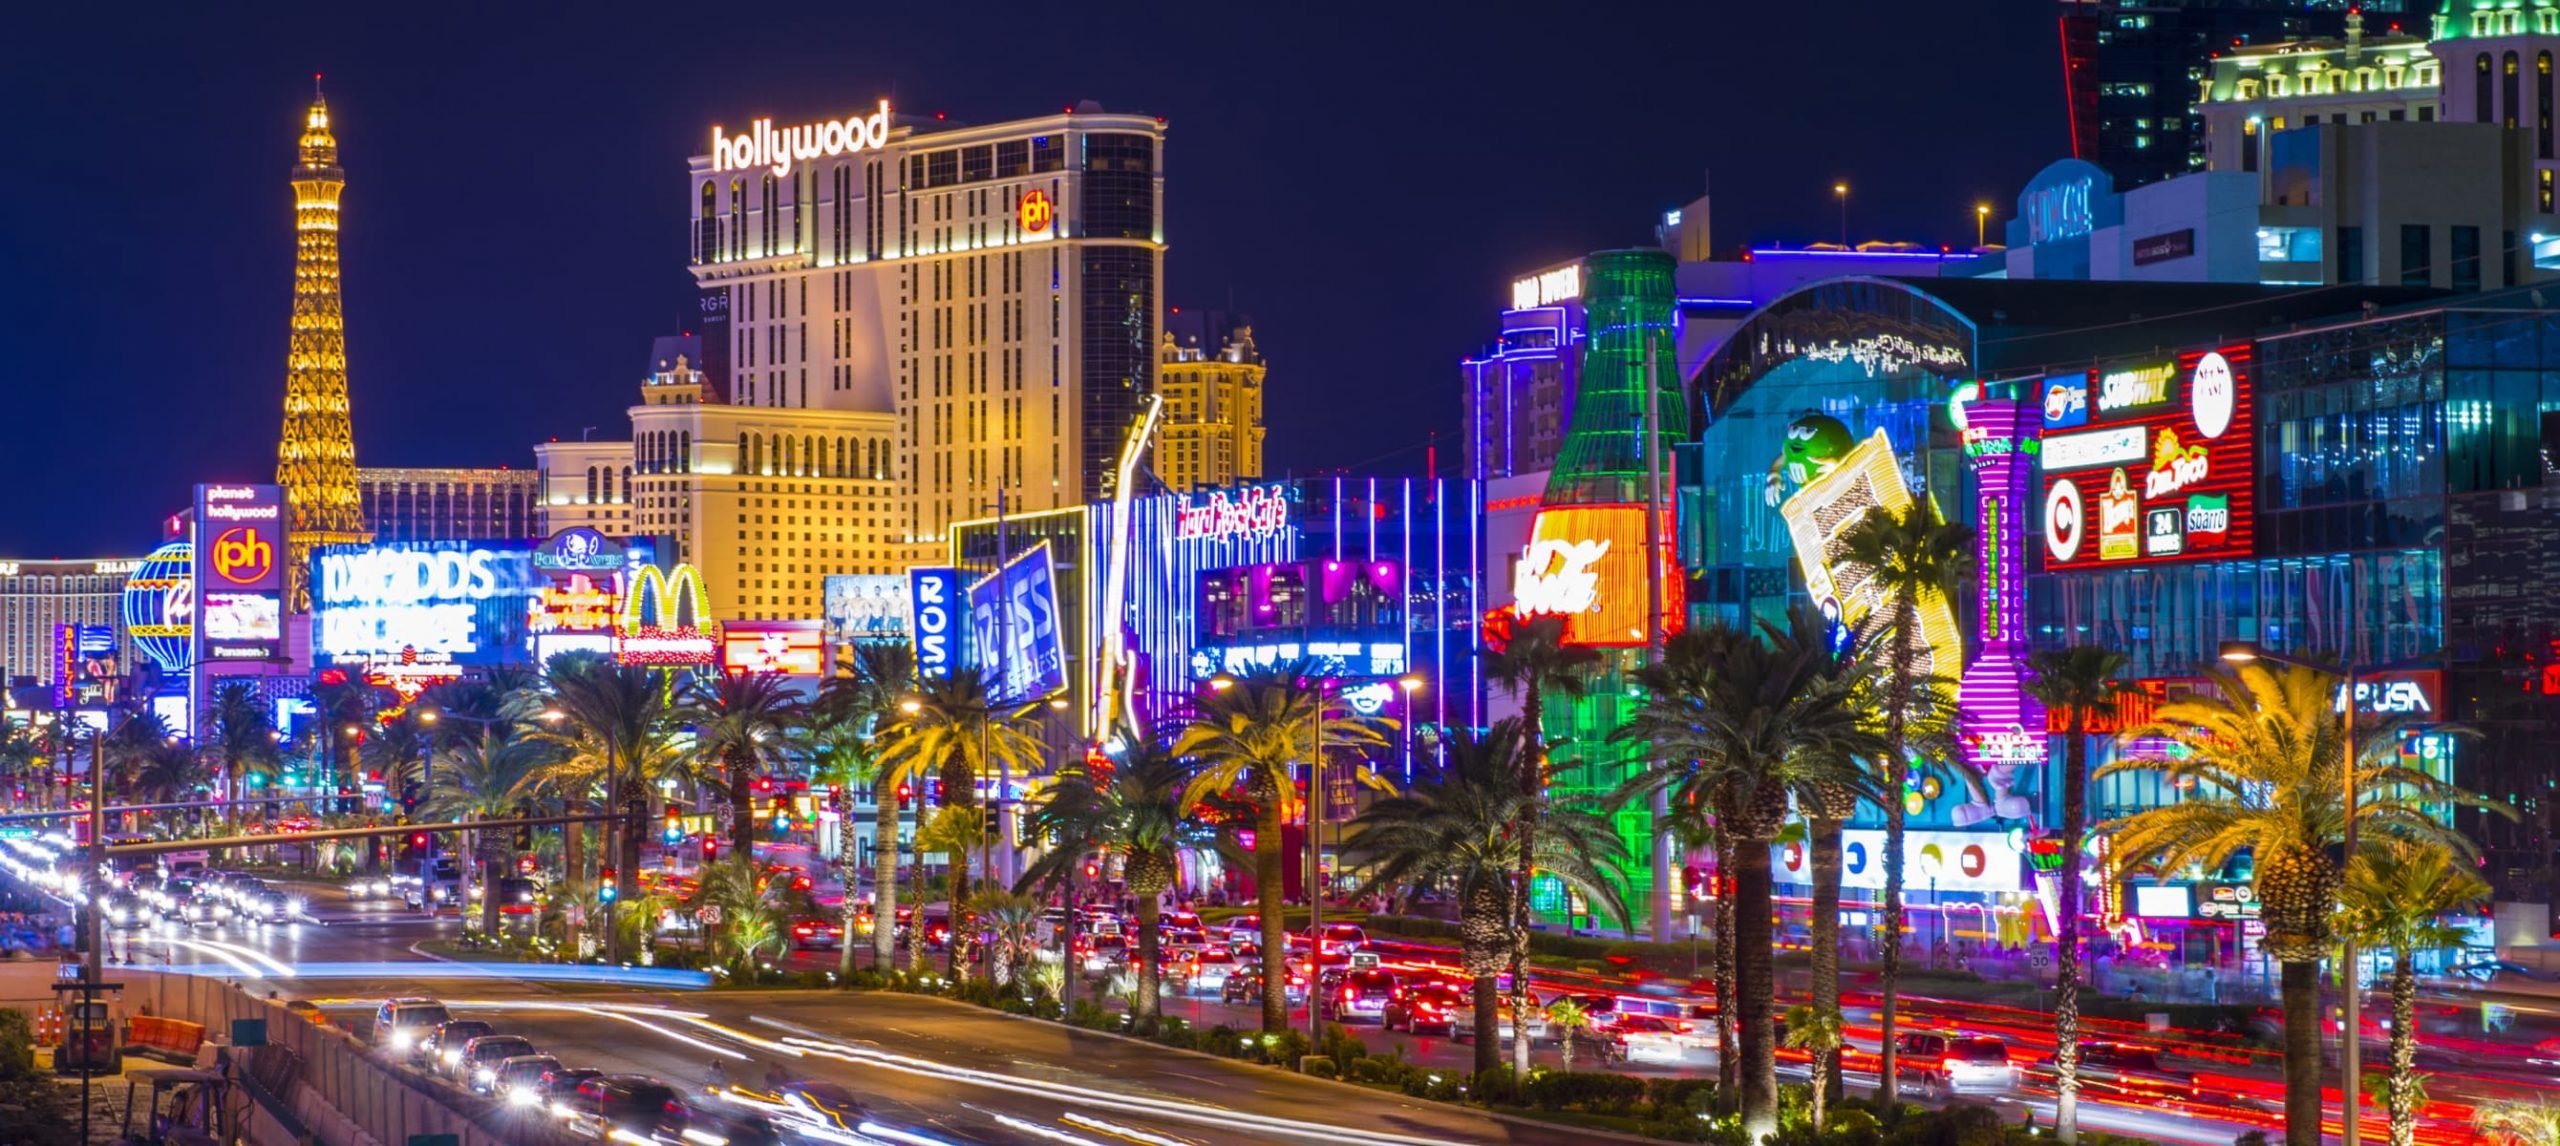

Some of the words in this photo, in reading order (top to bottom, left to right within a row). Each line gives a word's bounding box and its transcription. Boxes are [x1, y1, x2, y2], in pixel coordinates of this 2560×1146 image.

[713, 99, 889, 178] hollywood
[2099, 362, 2175, 413] SUBWAY
[208, 485, 254, 502] planet
[207, 504, 277, 521] hollywood
[1251, 485, 1287, 538] Cafe
[2154, 512, 2172, 535] 24
[2189, 504, 2225, 532] sbarro
[220, 528, 272, 576] ph
[2259, 555, 2422, 667] RESORTS
[2372, 682, 2431, 712] USA
[2033, 956, 2048, 967] 30
